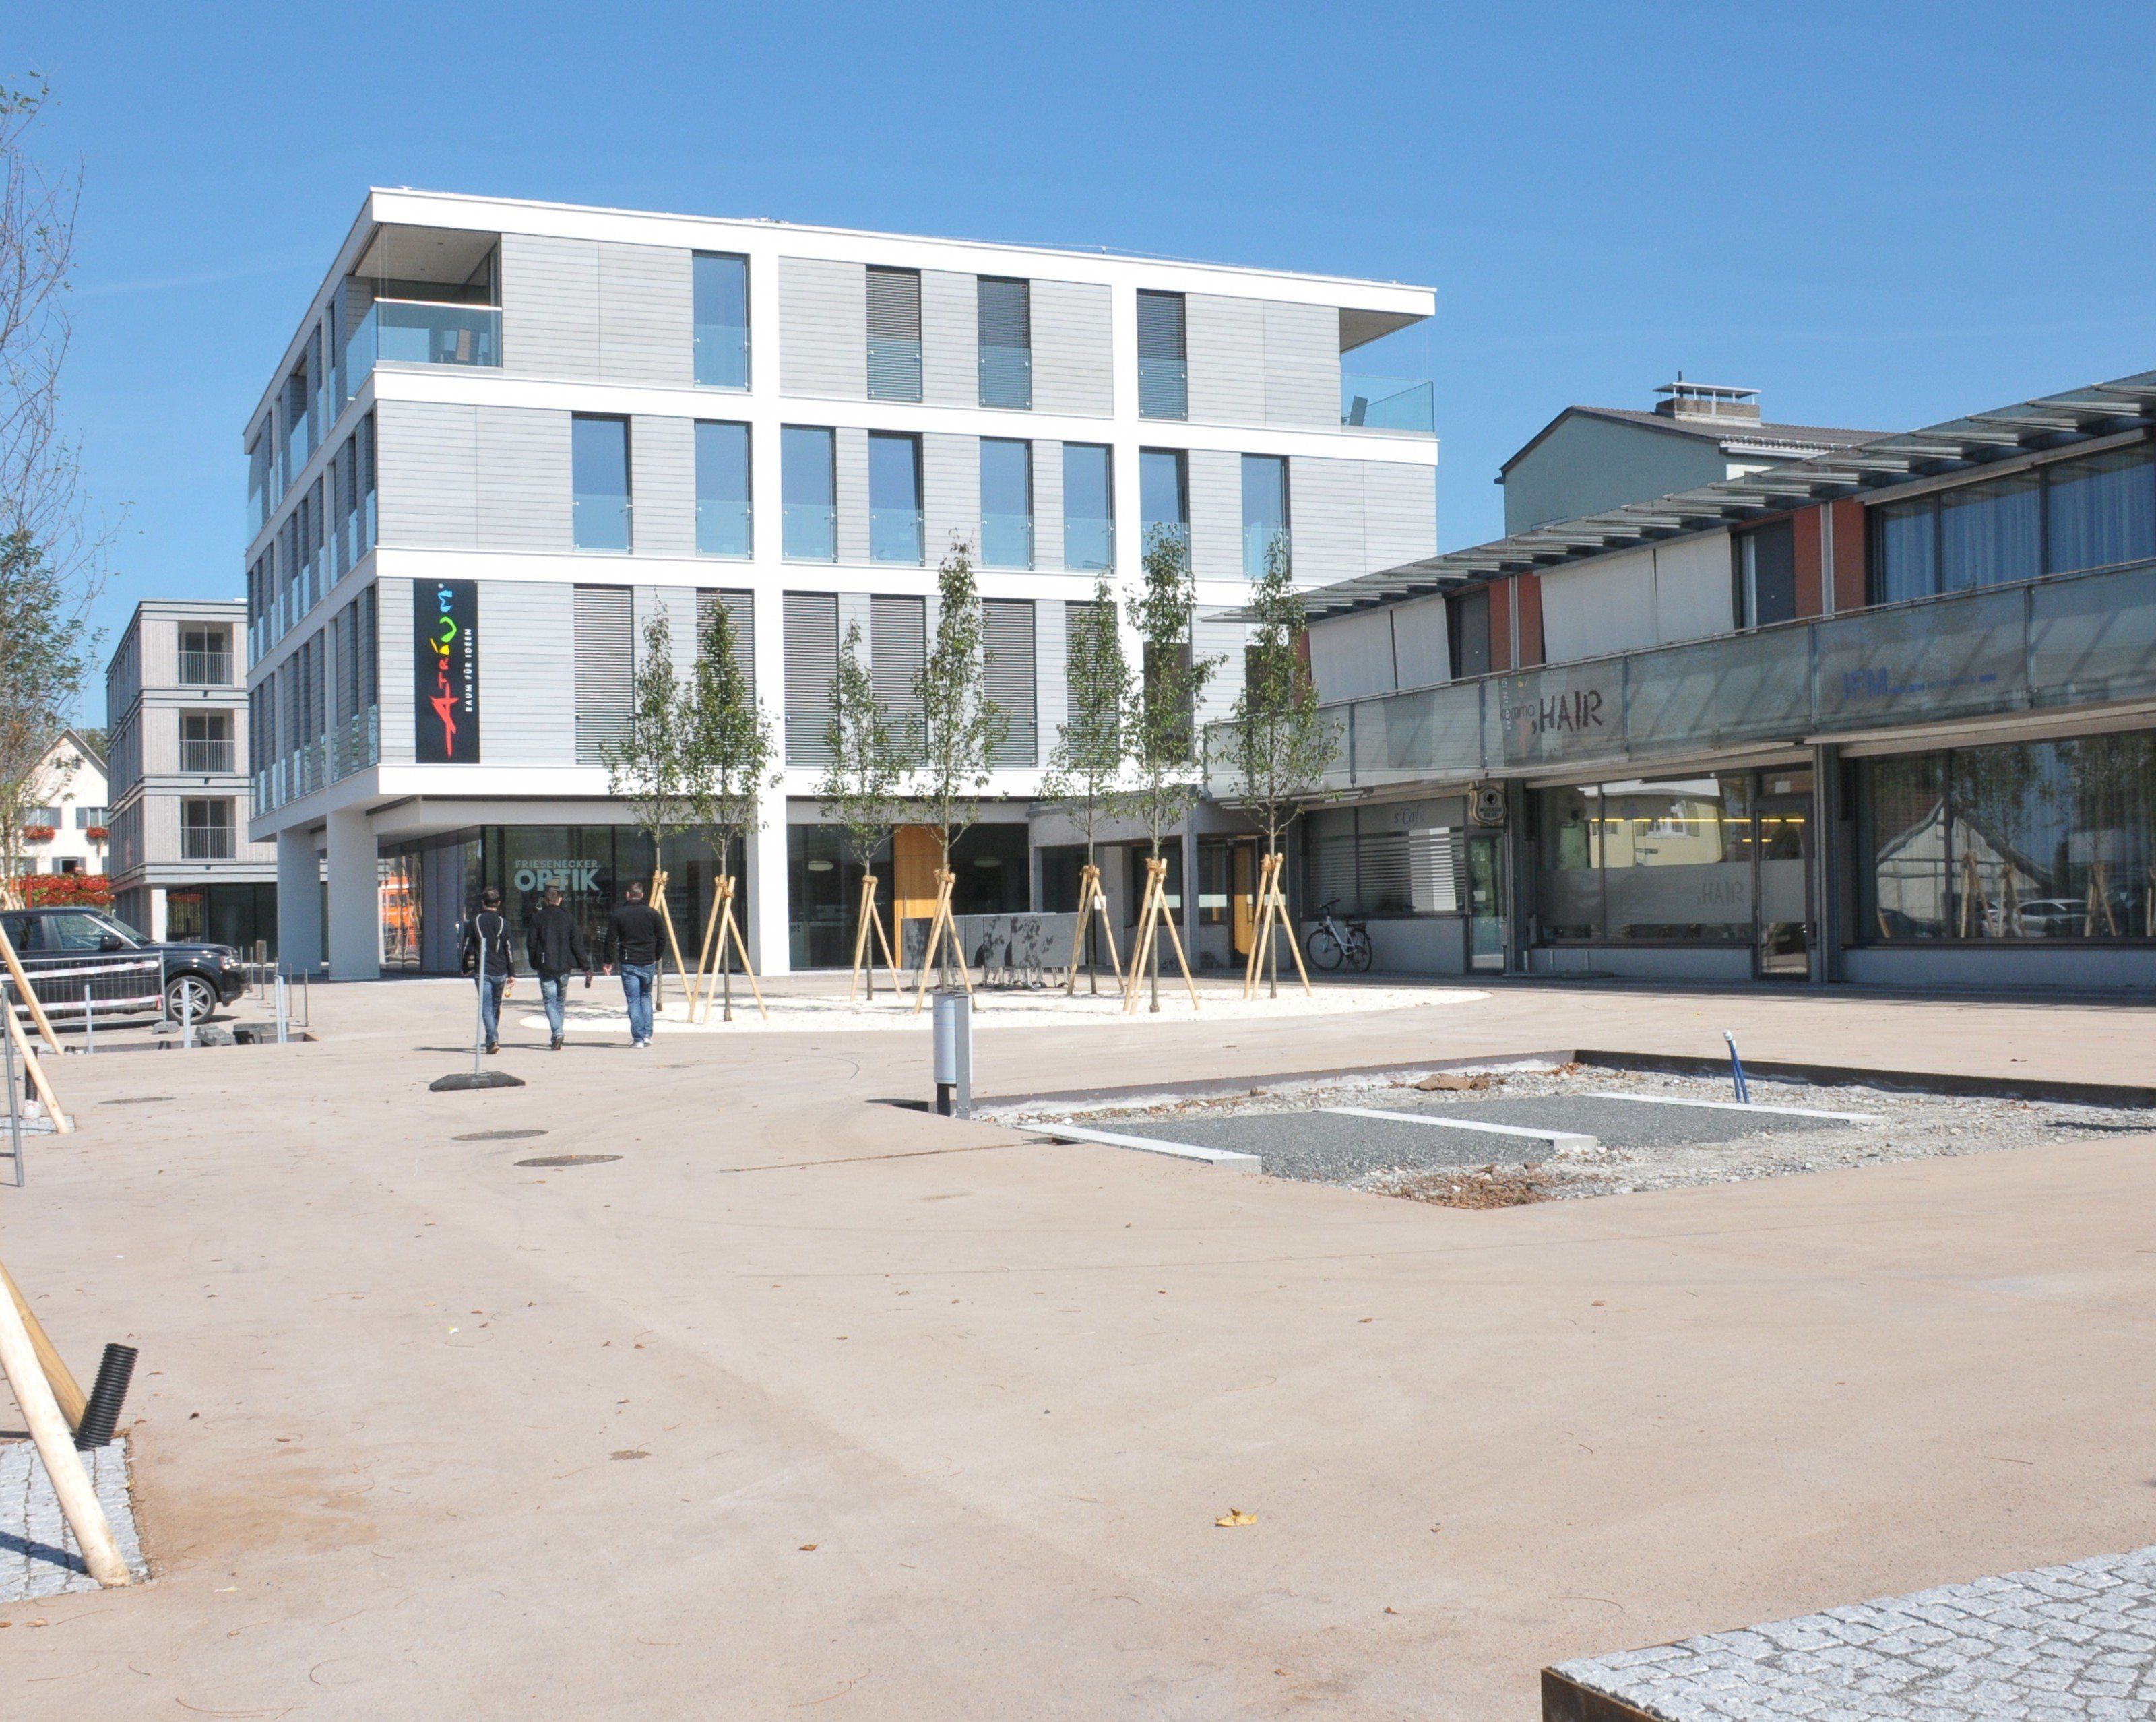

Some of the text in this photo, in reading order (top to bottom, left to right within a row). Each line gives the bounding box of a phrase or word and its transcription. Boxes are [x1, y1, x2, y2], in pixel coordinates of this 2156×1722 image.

[463, 629, 473, 712] RAUM FÜR IDEEN
[514, 868, 600, 891] OPTIK
